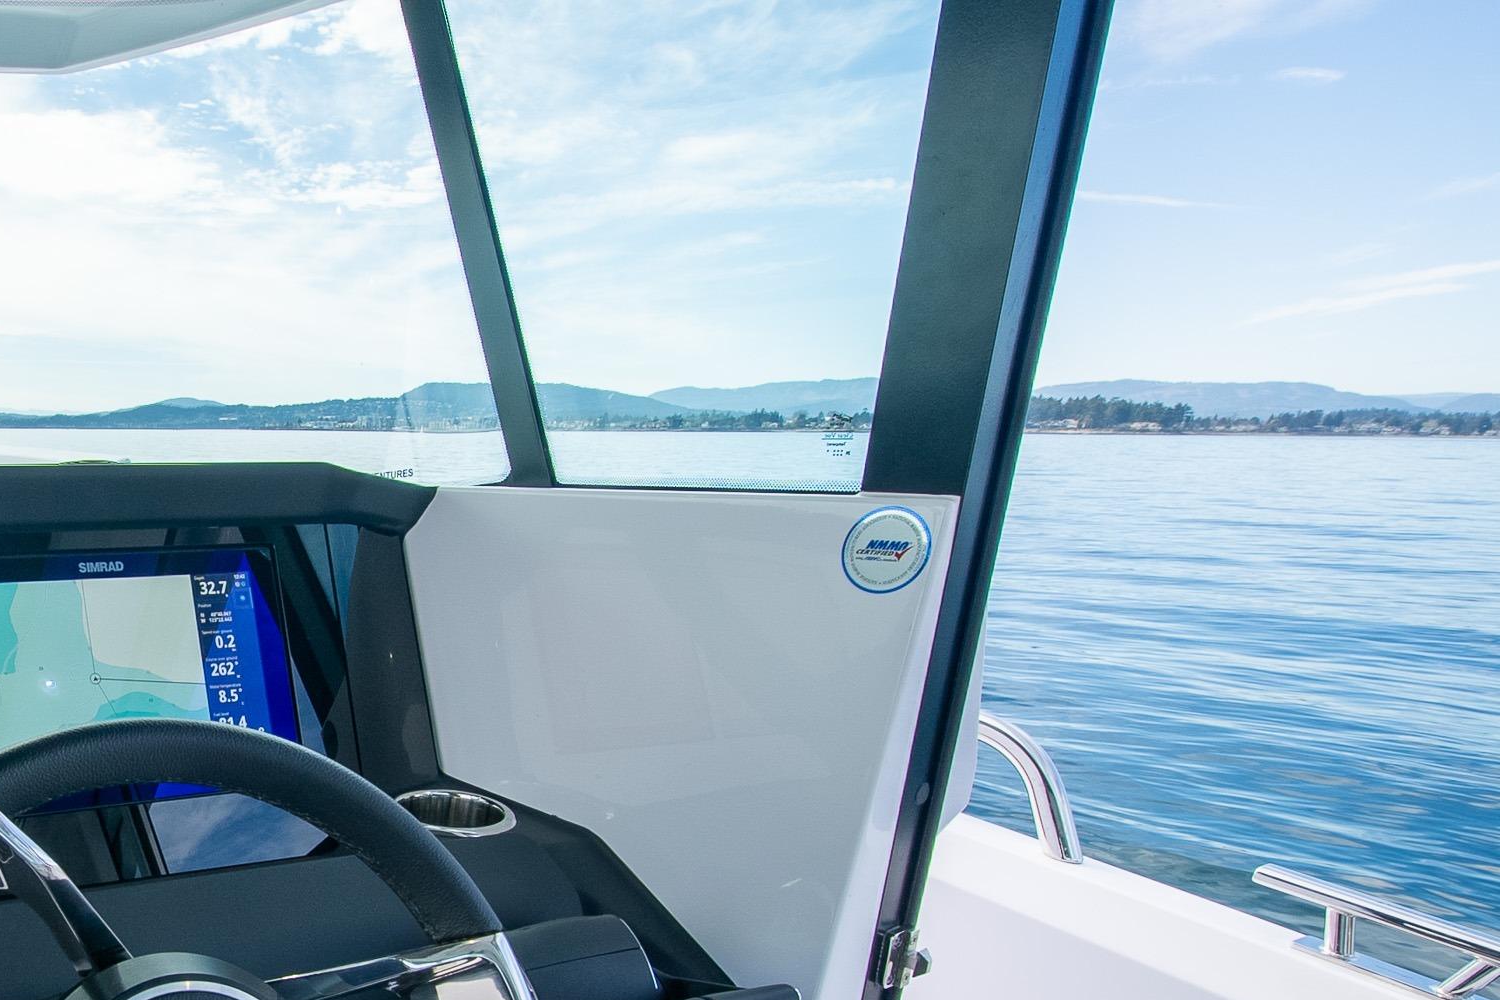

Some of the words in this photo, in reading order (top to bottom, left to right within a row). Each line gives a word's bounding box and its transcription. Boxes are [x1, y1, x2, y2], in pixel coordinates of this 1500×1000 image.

[78, 561, 124, 574] SIMRAD
[199, 580, 227, 595] 32.7
[215, 634, 236, 649] 0.2
